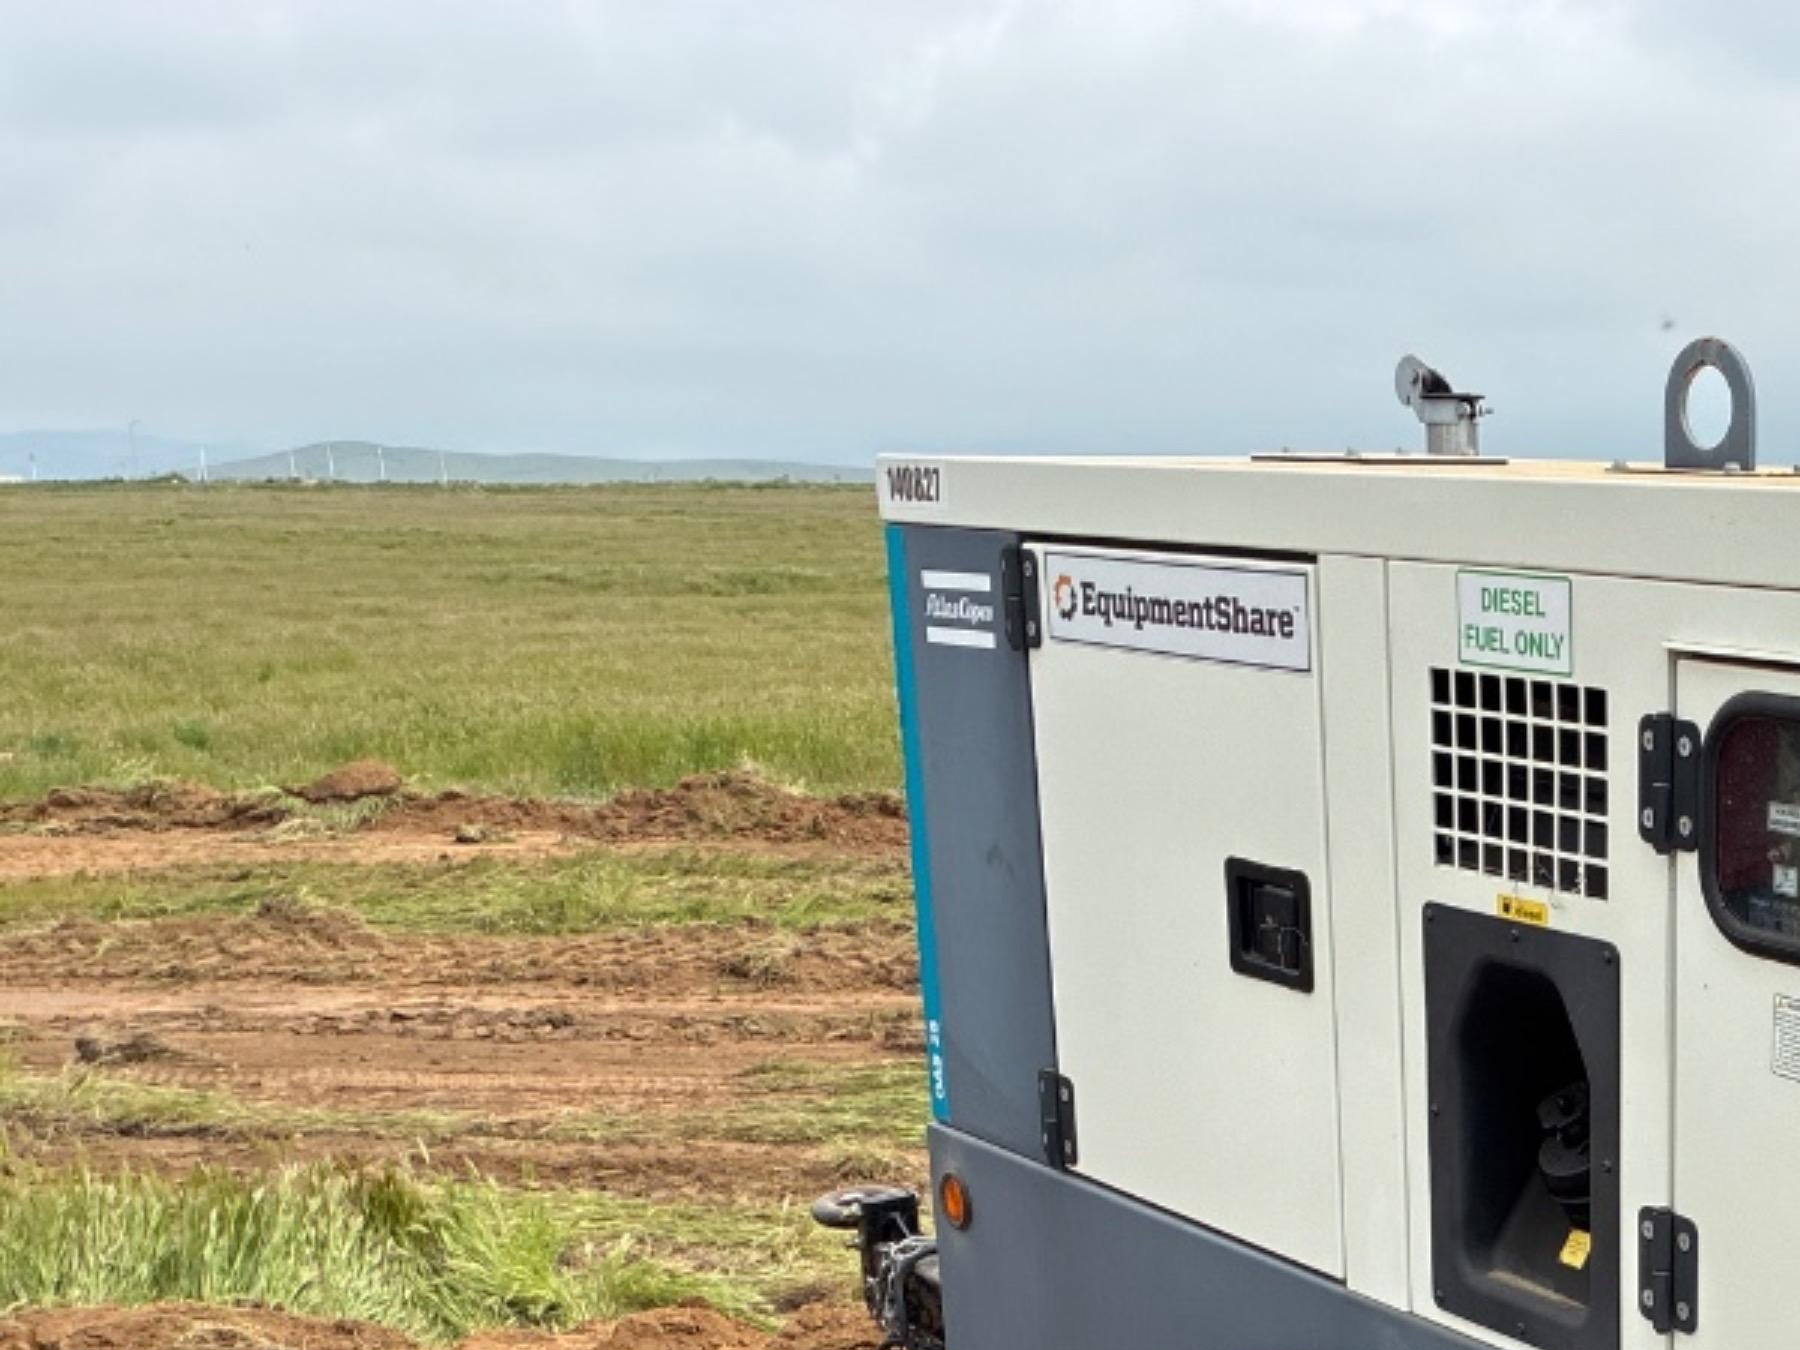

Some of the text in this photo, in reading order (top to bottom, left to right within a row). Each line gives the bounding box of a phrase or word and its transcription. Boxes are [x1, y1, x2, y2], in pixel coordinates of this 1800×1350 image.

[1080, 581, 1295, 639] EquipmentShare
[1480, 586, 1546, 617] DIESEL
[1463, 623, 1565, 662] FUEL ONLY
